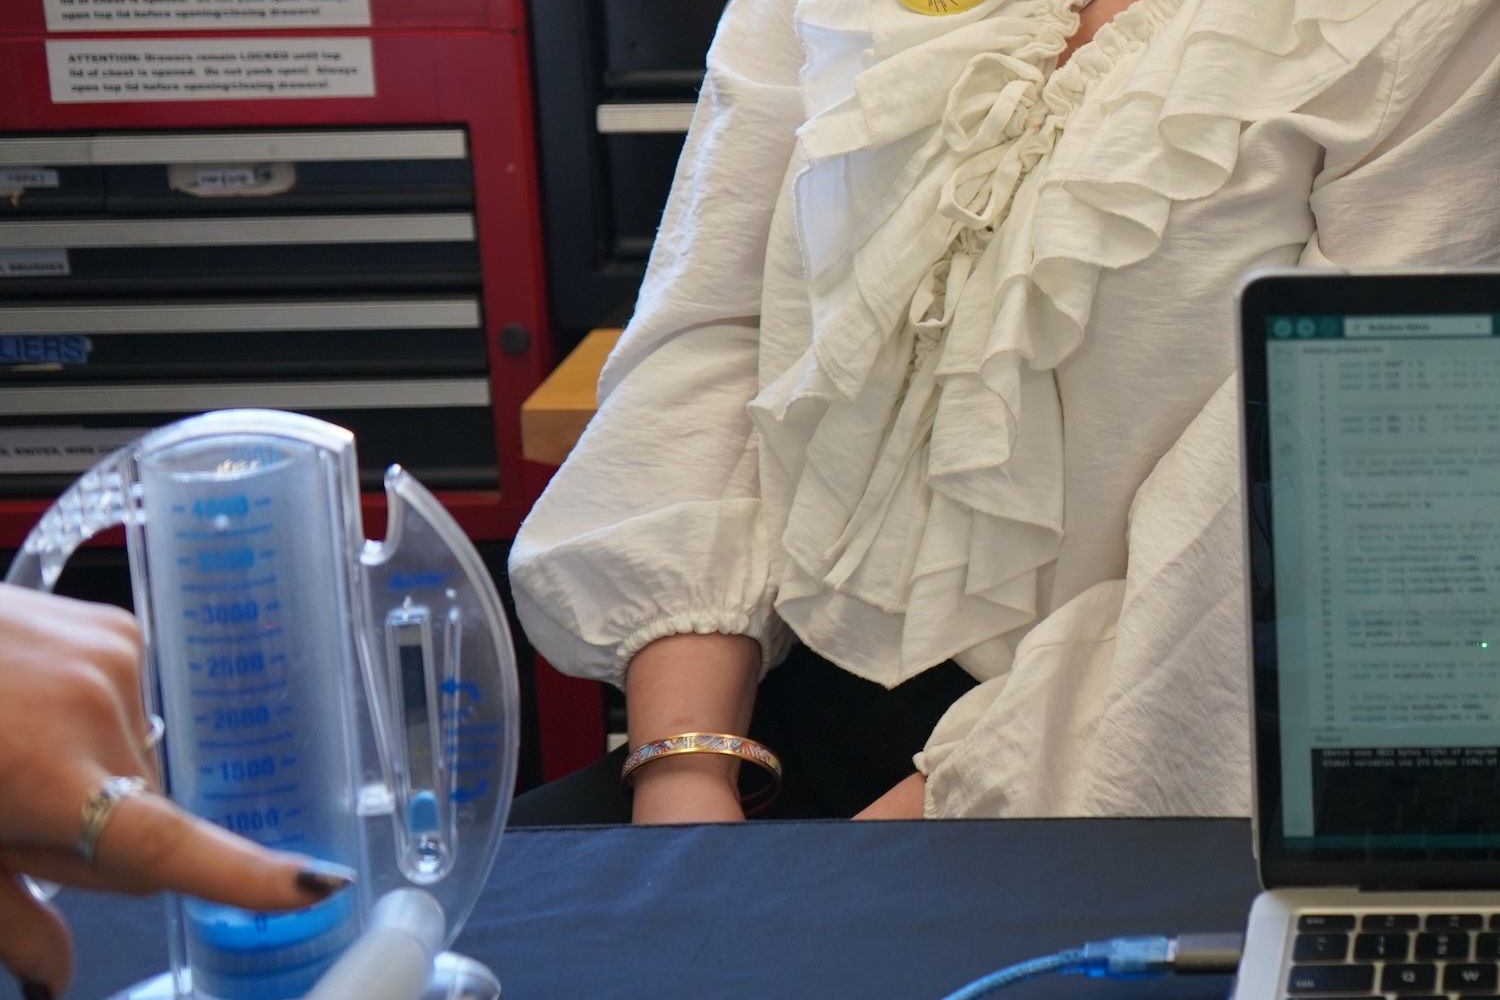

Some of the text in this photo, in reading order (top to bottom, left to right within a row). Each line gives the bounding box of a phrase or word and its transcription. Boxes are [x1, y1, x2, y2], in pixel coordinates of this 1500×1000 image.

[60, 11, 91, 21] open
[92, 10, 113, 20] top
[115, 10, 131, 20] lid
[132, 10, 172, 20] before
[221, 756, 275, 783] 1500
[1400, 970, 1415, 984] Q
[1461, 970, 1480, 982] W
